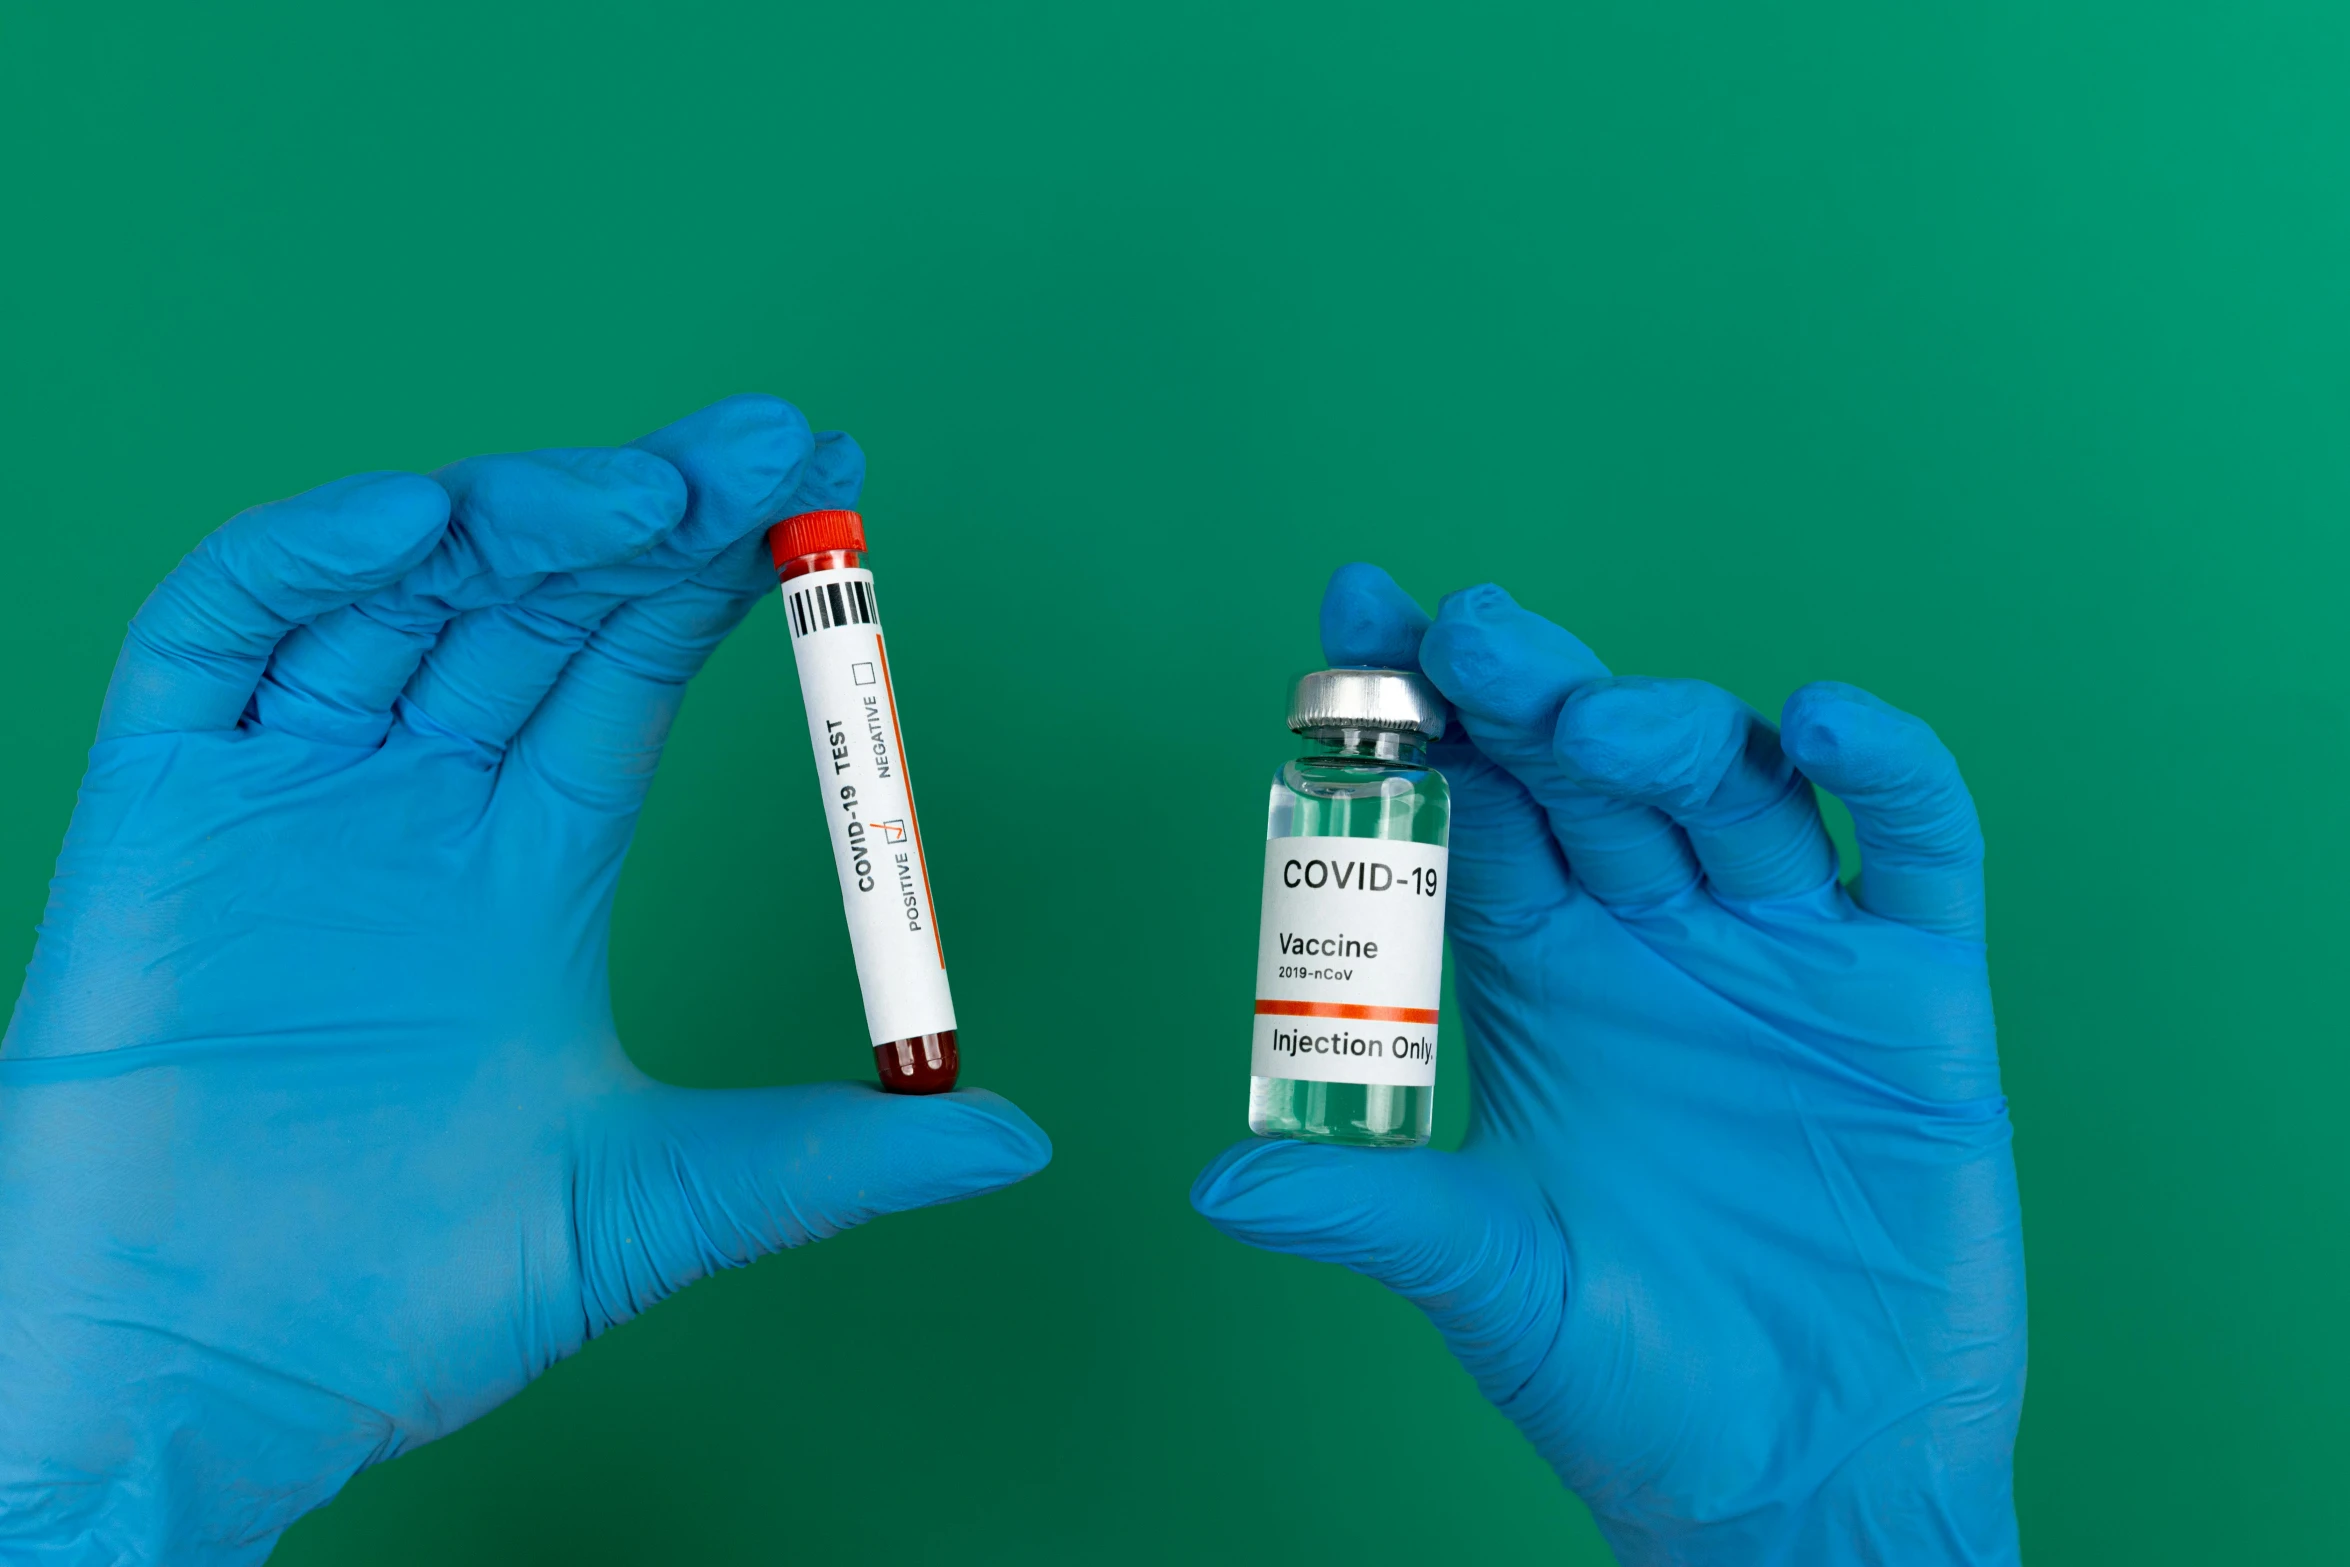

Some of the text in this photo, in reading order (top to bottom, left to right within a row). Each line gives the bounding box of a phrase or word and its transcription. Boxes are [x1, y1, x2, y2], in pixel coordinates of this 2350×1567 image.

[863, 695, 891, 779] NEGATIVE
[826, 719, 875, 893] COVID-19 TEST
[895, 852, 922, 932] POSITIVE
[1283, 859, 1438, 897] COVID-19
[1279, 932, 1378, 959] Vaccine
[1278, 966, 1353, 981] 2019-nCoV
[1273, 1028, 1434, 1065] Injection Only.
